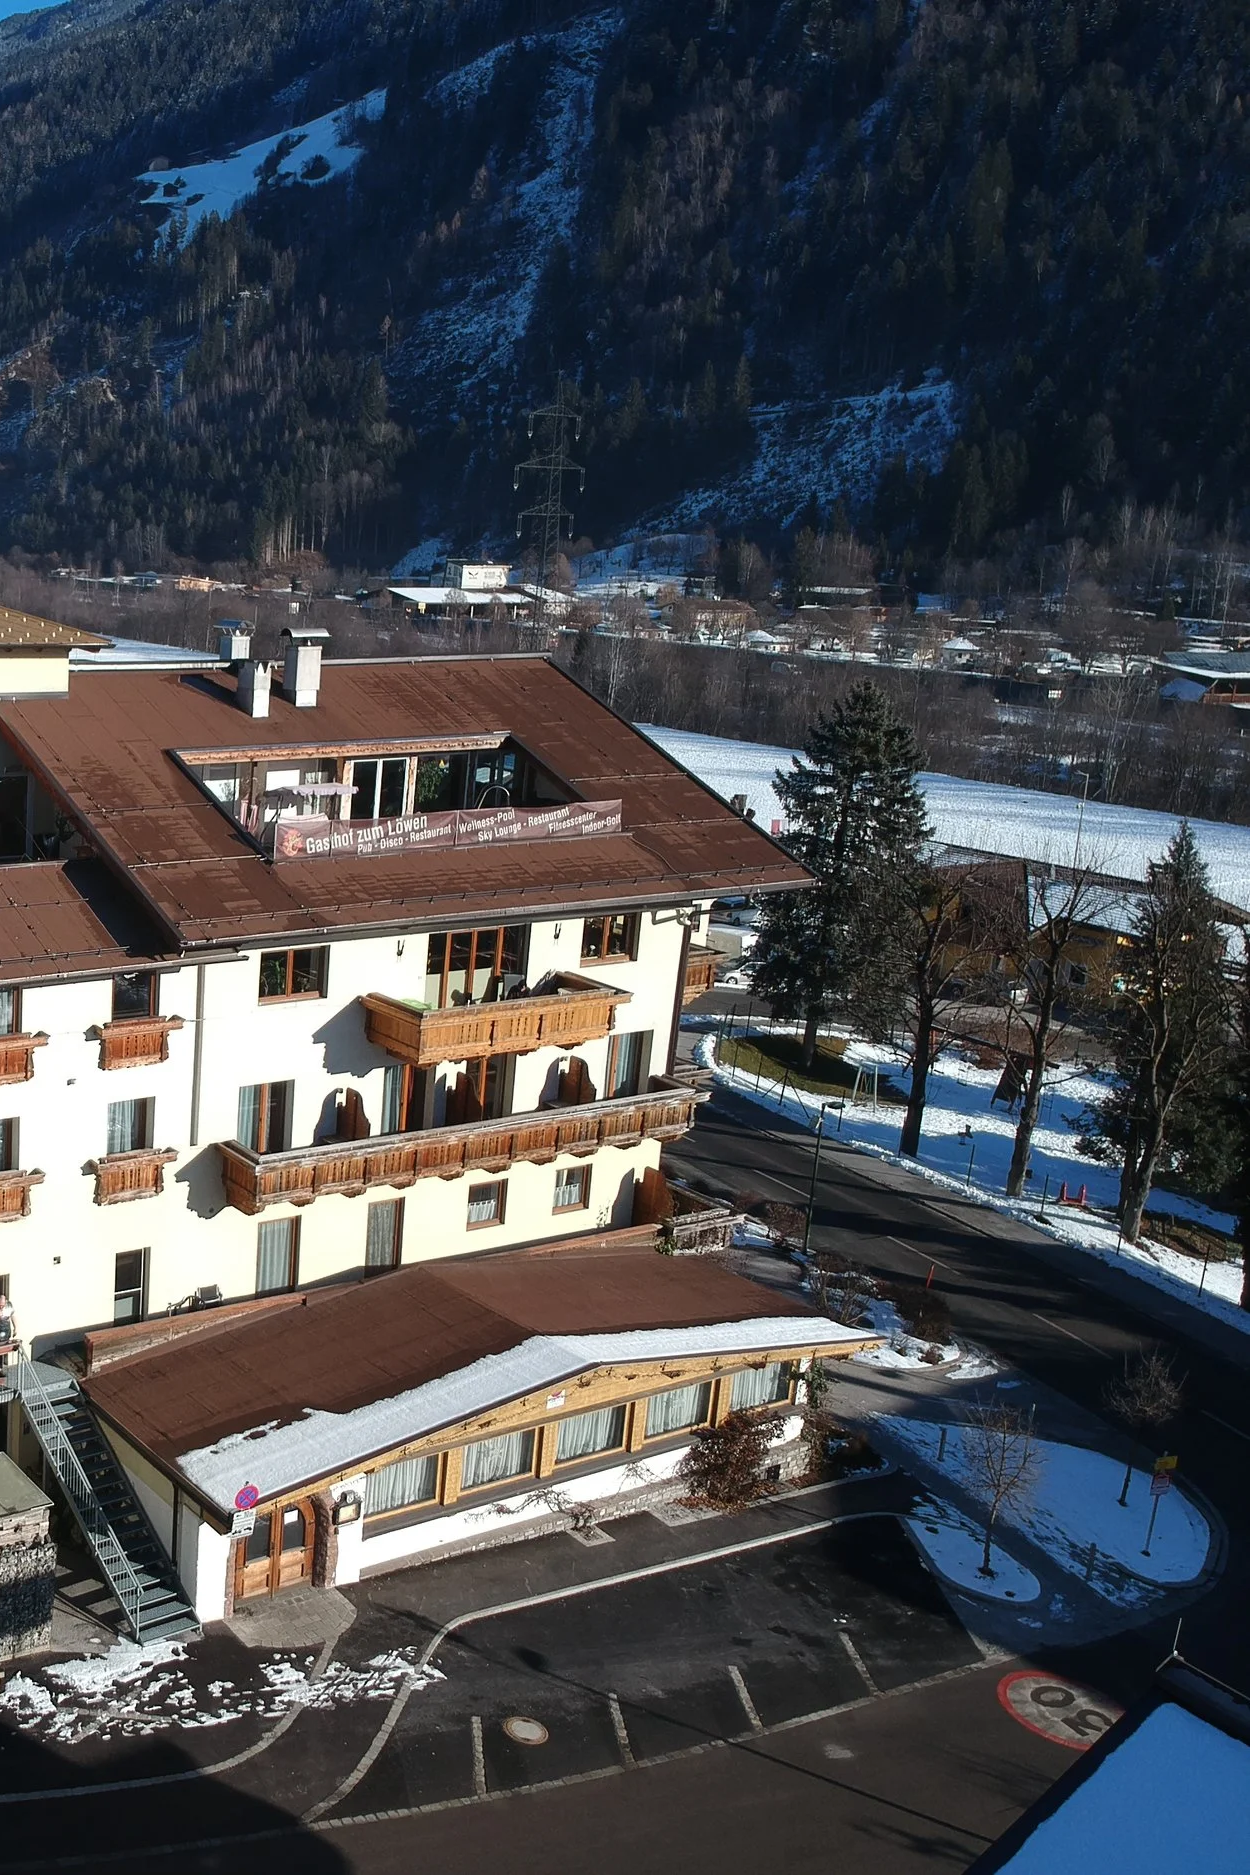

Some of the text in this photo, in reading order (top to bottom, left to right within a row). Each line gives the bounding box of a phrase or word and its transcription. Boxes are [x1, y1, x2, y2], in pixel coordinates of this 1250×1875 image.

[306, 815, 428, 854] Gasthof zum Löwen
[458, 810, 516, 834] Wellness-Pool
[478, 829, 493, 842] Sky
[494, 824, 522, 839] Lounge
[528, 806, 570, 826] Restaurant
[548, 811, 597, 834] Fitnesscenter
[582, 813, 622, 835] Indoor-Golf
[357, 842, 373, 855] Pub
[380, 836, 404, 849] Disco
[410, 824, 452, 843] Restaurant
[1030, 1685, 1114, 1737] 30
